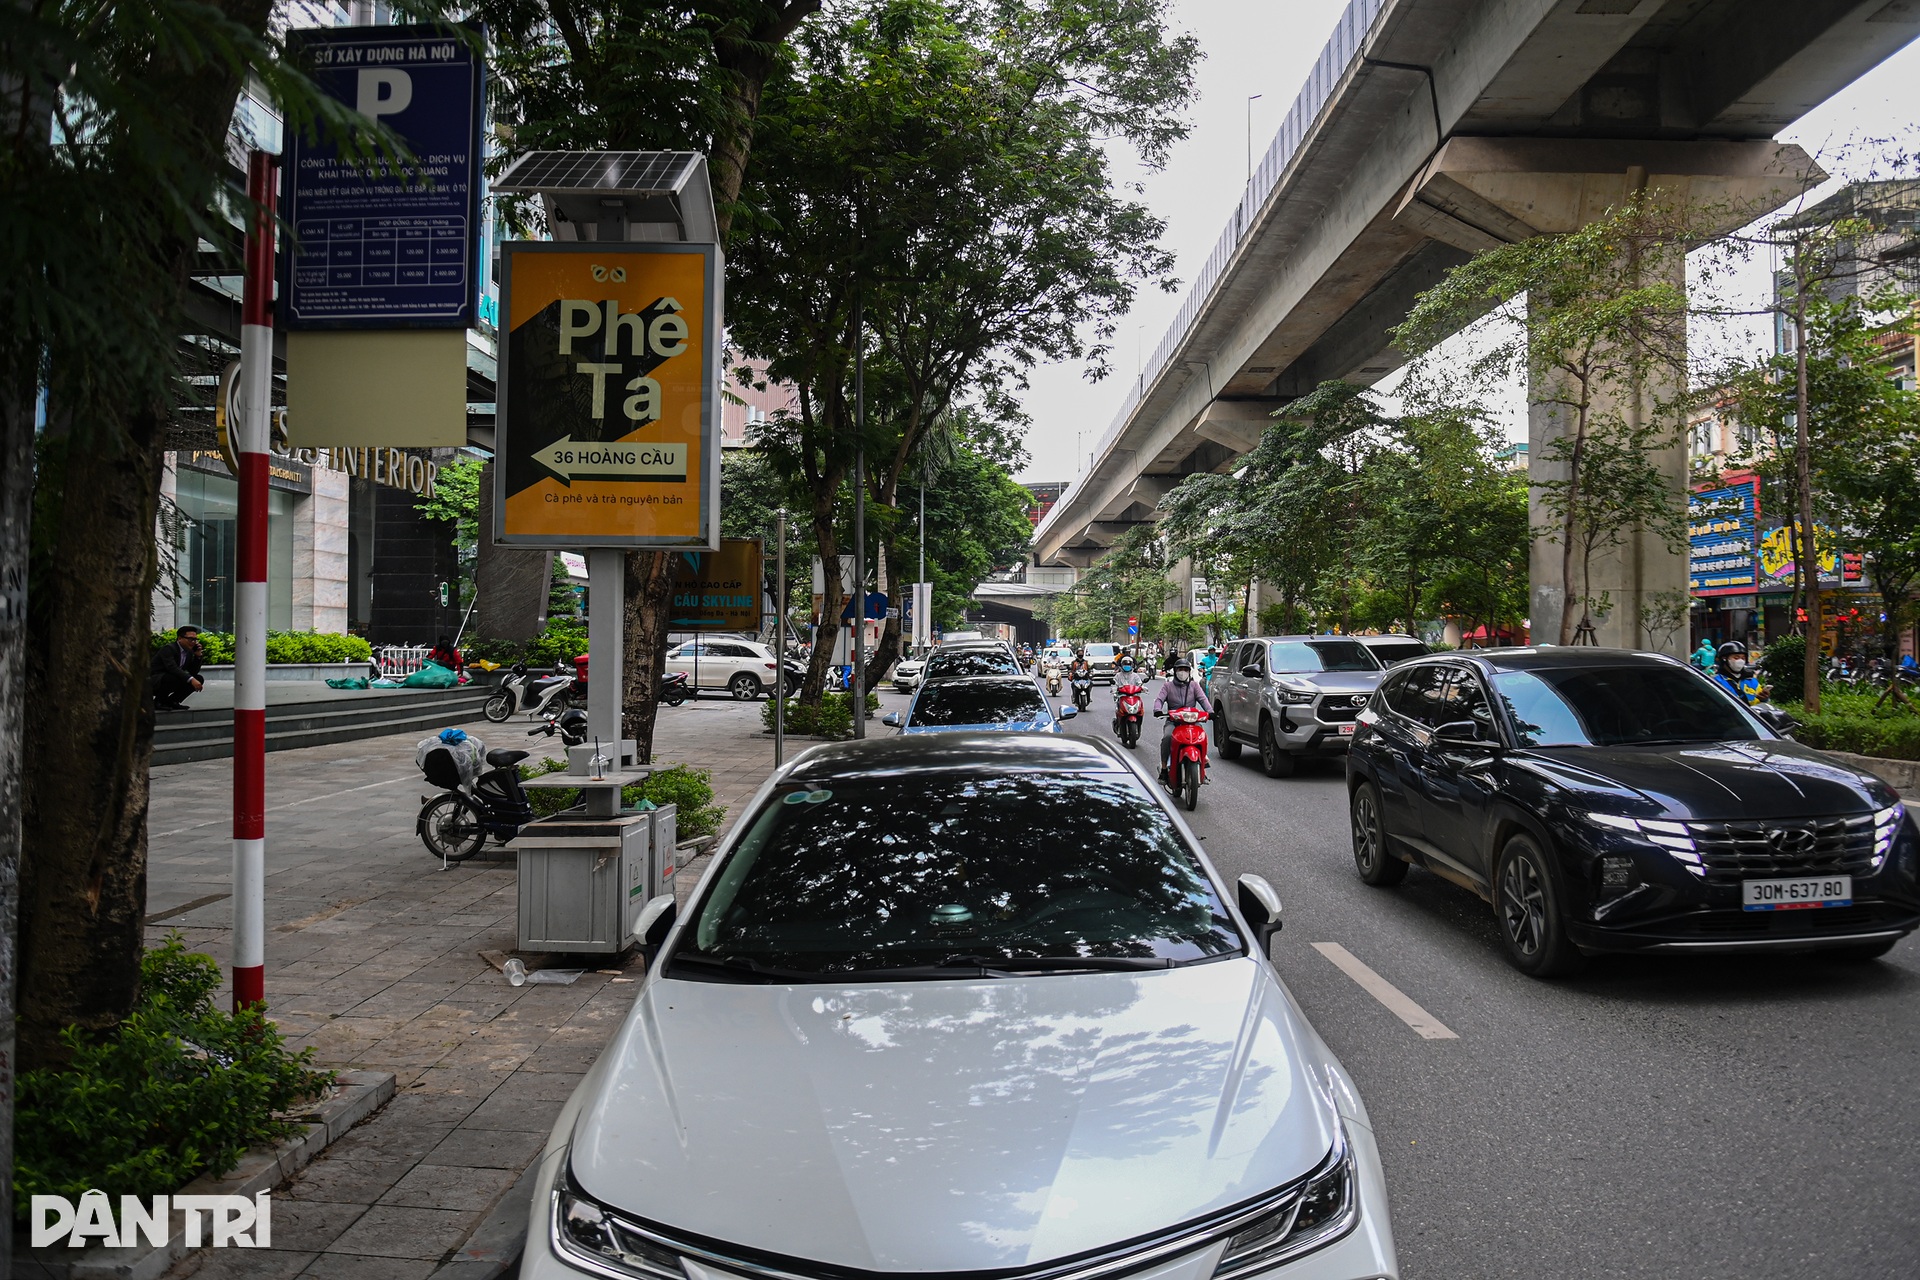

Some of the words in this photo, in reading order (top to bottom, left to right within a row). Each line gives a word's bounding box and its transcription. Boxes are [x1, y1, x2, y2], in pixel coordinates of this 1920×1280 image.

[337, 47, 362, 64] XÂY
[367, 46, 404, 64] DỰNG
[408, 43, 427, 60] HÀ
[431, 42, 456, 60] NỘI
[357, 68, 413, 146] P
[301, 157, 325, 168] CÔNG
[429, 154, 451, 165] DỊCH
[453, 154, 465, 165] VỤ
[318, 169, 339, 179] KHAI
[558, 296, 689, 357] Phê
[576, 362, 662, 421] Ta
[554, 450, 574, 464] 36
[578, 447, 636, 465] HOÀNG
[640, 448, 675, 465] CẦU
[544, 493, 559, 503] Cà
[562, 493, 583, 505] phê
[586, 494, 599, 503] và
[602, 493, 616, 504] trà
[620, 494, 659, 506] nguyên
[662, 494, 683, 505] bản
[700, 581, 720, 589] CAO
[722, 578, 742, 589] CẤP
[674, 591, 699, 607] CẦU
[702, 595, 753, 607] SKYLINE
[1753, 881, 1843, 901] 30M-637.80
